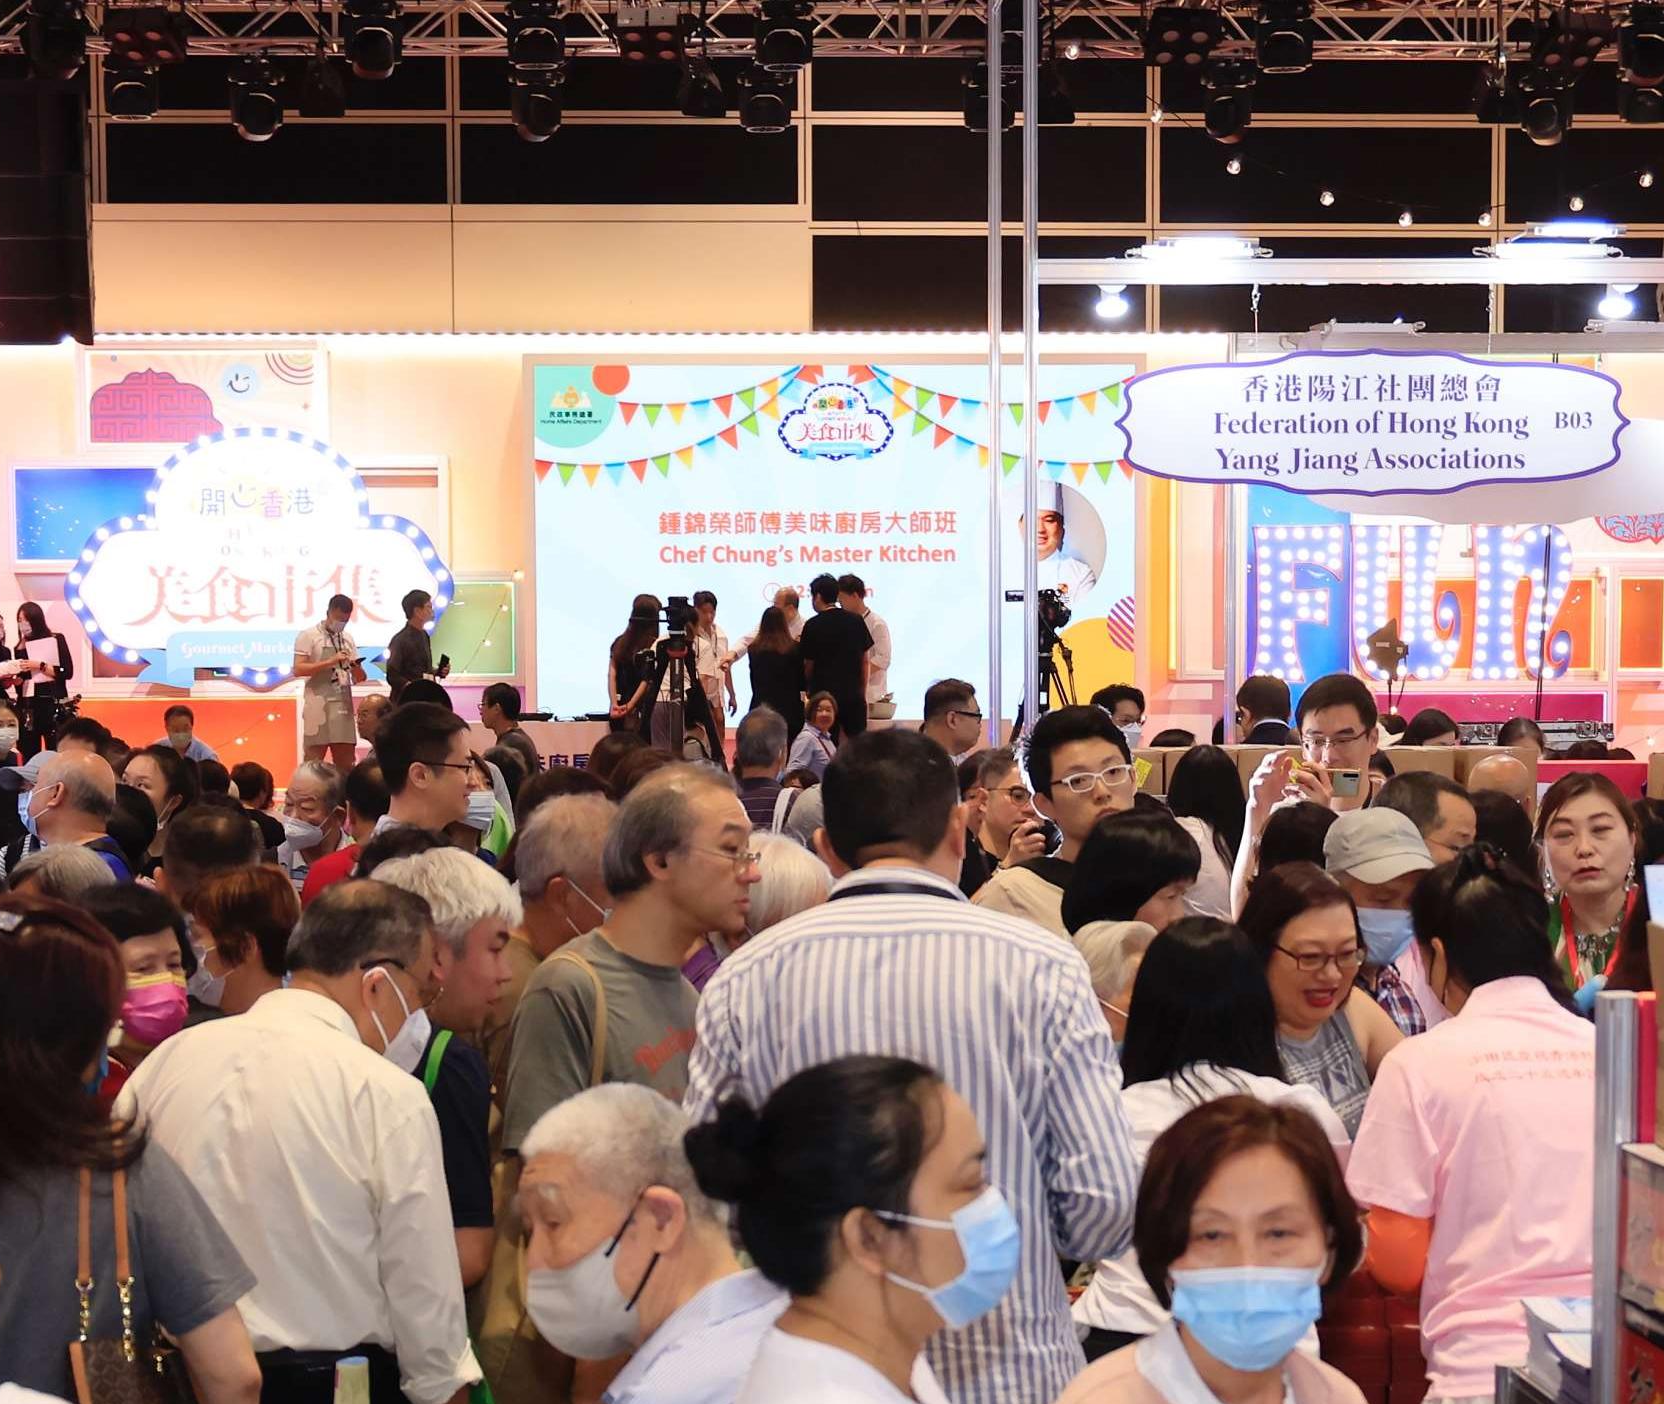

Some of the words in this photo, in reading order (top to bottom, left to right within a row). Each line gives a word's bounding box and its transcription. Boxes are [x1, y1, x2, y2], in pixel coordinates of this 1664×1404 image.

[1242, 373, 1502, 404] 香港陽江社團總會
[1213, 411, 1349, 435] Federation
[1355, 410, 1384, 435] of
[1387, 411, 1458, 440] Hong
[1463, 411, 1530, 440] Kong
[1553, 411, 1593, 430] B03
[1215, 447, 1280, 476] Yang
[1287, 446, 1359, 476] Jiang
[1364, 446, 1526, 470] Associations
[658, 511, 957, 535] 鍾錦榮師傅美味廚房大師班
[659, 545, 707, 563] Chef
[800, 546, 873, 563] Master
[879, 545, 956, 563] Kitchen
[123, 563, 392, 627] 美食市集
[181, 641, 245, 659] Gourmet
[245, 640, 296, 659] Marke
